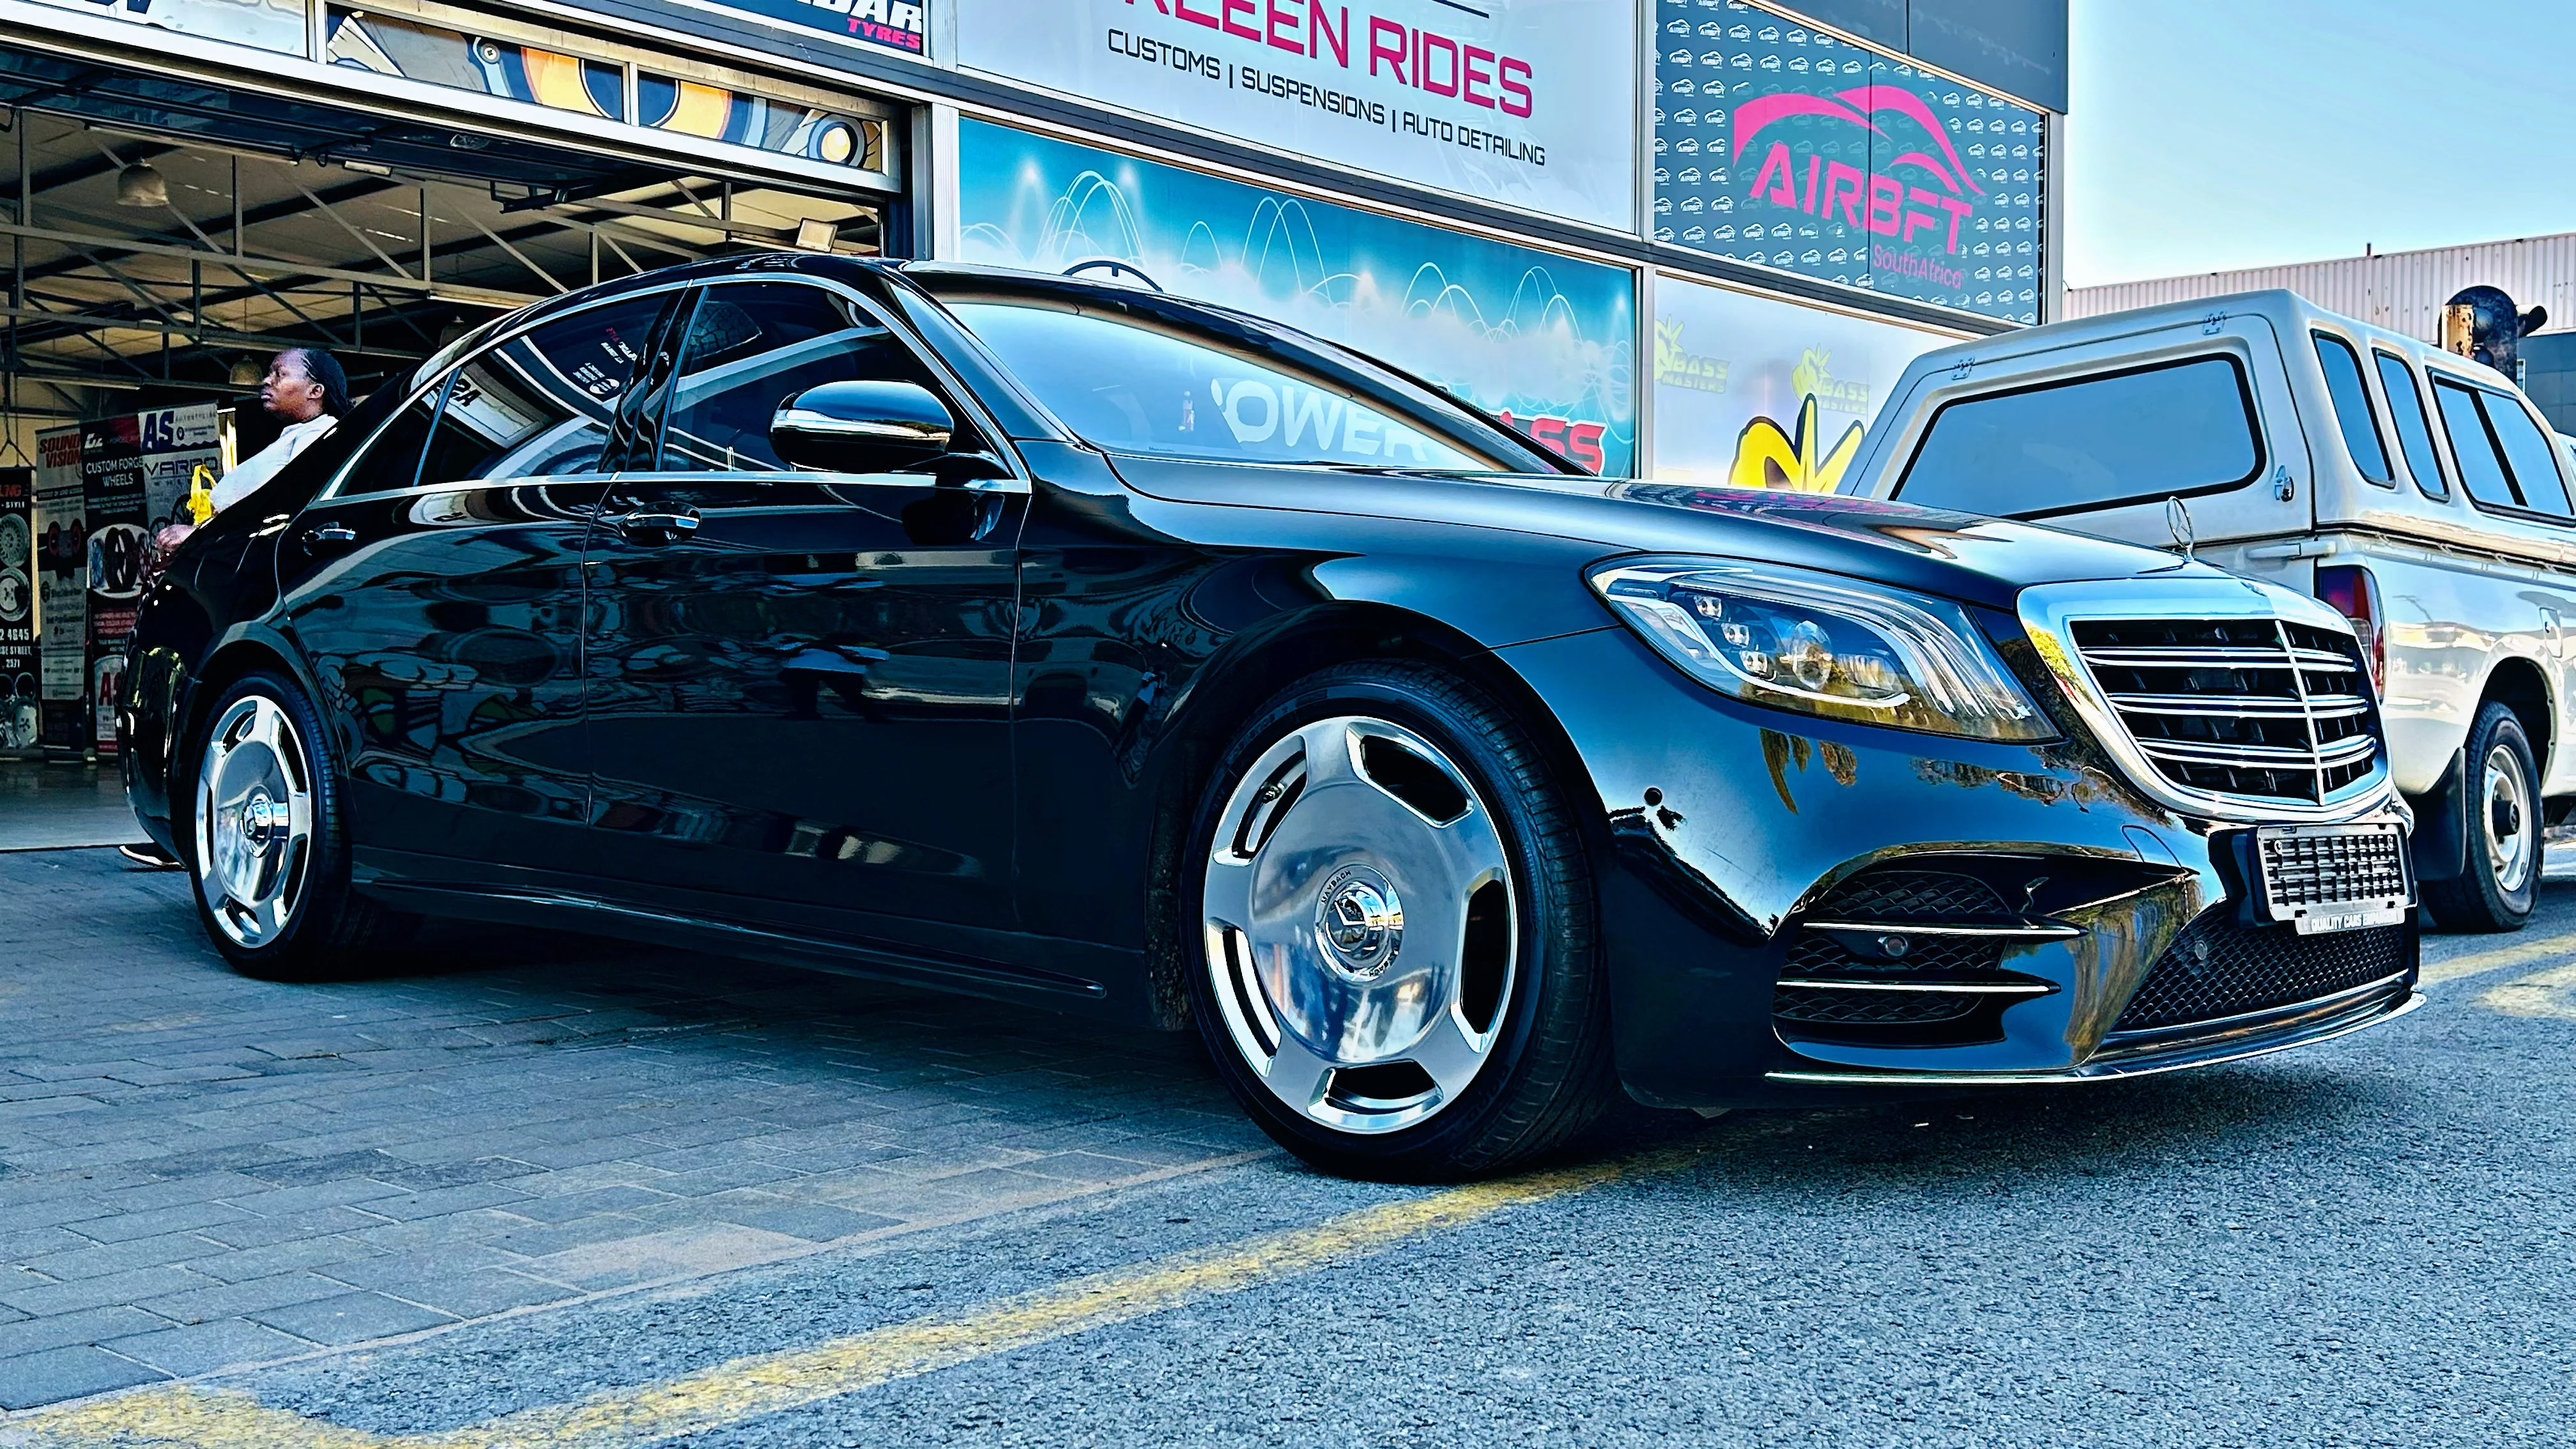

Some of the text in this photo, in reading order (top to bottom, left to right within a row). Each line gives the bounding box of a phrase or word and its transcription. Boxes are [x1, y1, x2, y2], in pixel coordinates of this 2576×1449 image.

[796, 0, 922, 33] AR
[847, 17, 921, 49] TYRES
[1125, 0, 1533, 119] LEEN RIDES
[1108, 28, 1220, 80] CUSTOMS
[1242, 66, 1385, 125] SUSPENSIONS
[1403, 112, 1453, 142] AUTO
[1457, 127, 1546, 166] DETAILING
[1749, 141, 1974, 255] AIRBFT
[141, 411, 174, 450] AS
[1211, 378, 1429, 462] OWER
[86, 459, 117, 474] CUSTOM
[102, 473, 134, 487] WHEELS
[1321, 870, 1352, 905] MAYBACH
[2311, 916, 2343, 932] QUALITY
